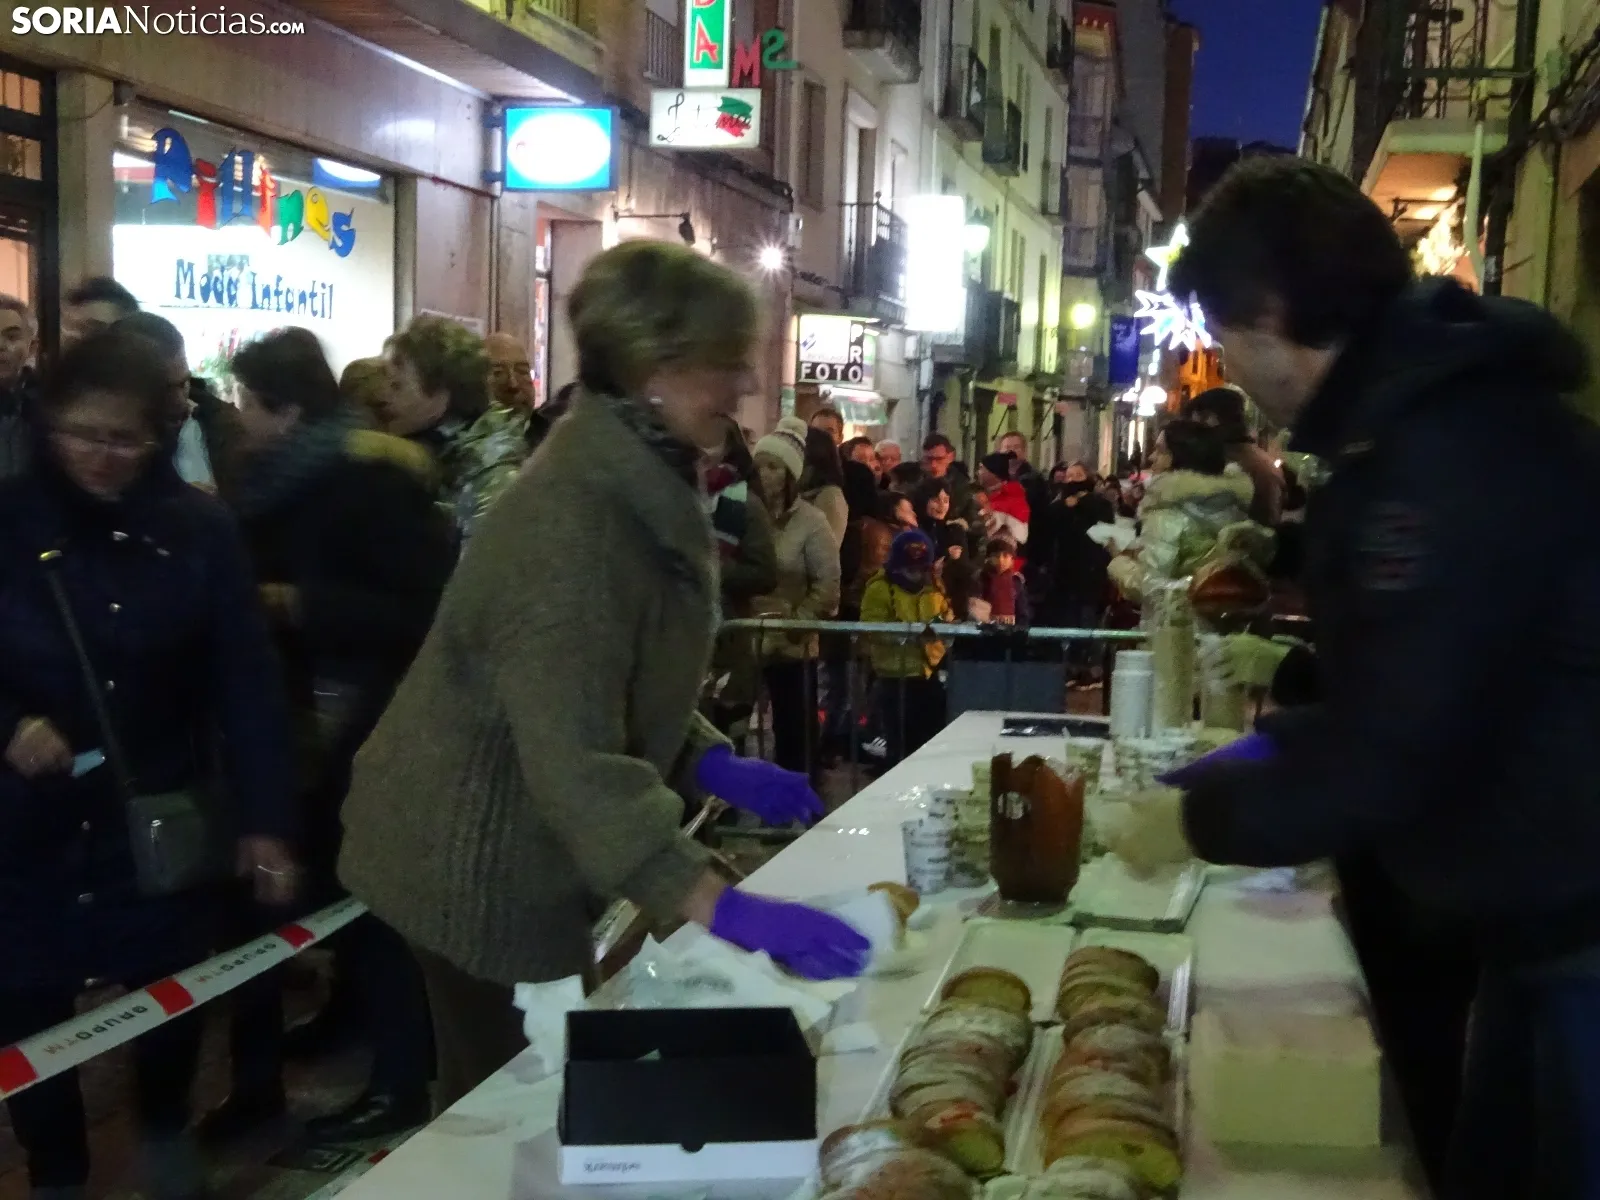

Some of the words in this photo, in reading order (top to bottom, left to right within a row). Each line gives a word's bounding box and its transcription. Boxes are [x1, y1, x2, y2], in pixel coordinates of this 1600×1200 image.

[174, 258, 240, 307] Moda
[248, 271, 333, 319] Infantil
[801, 361, 863, 384] FOTO
